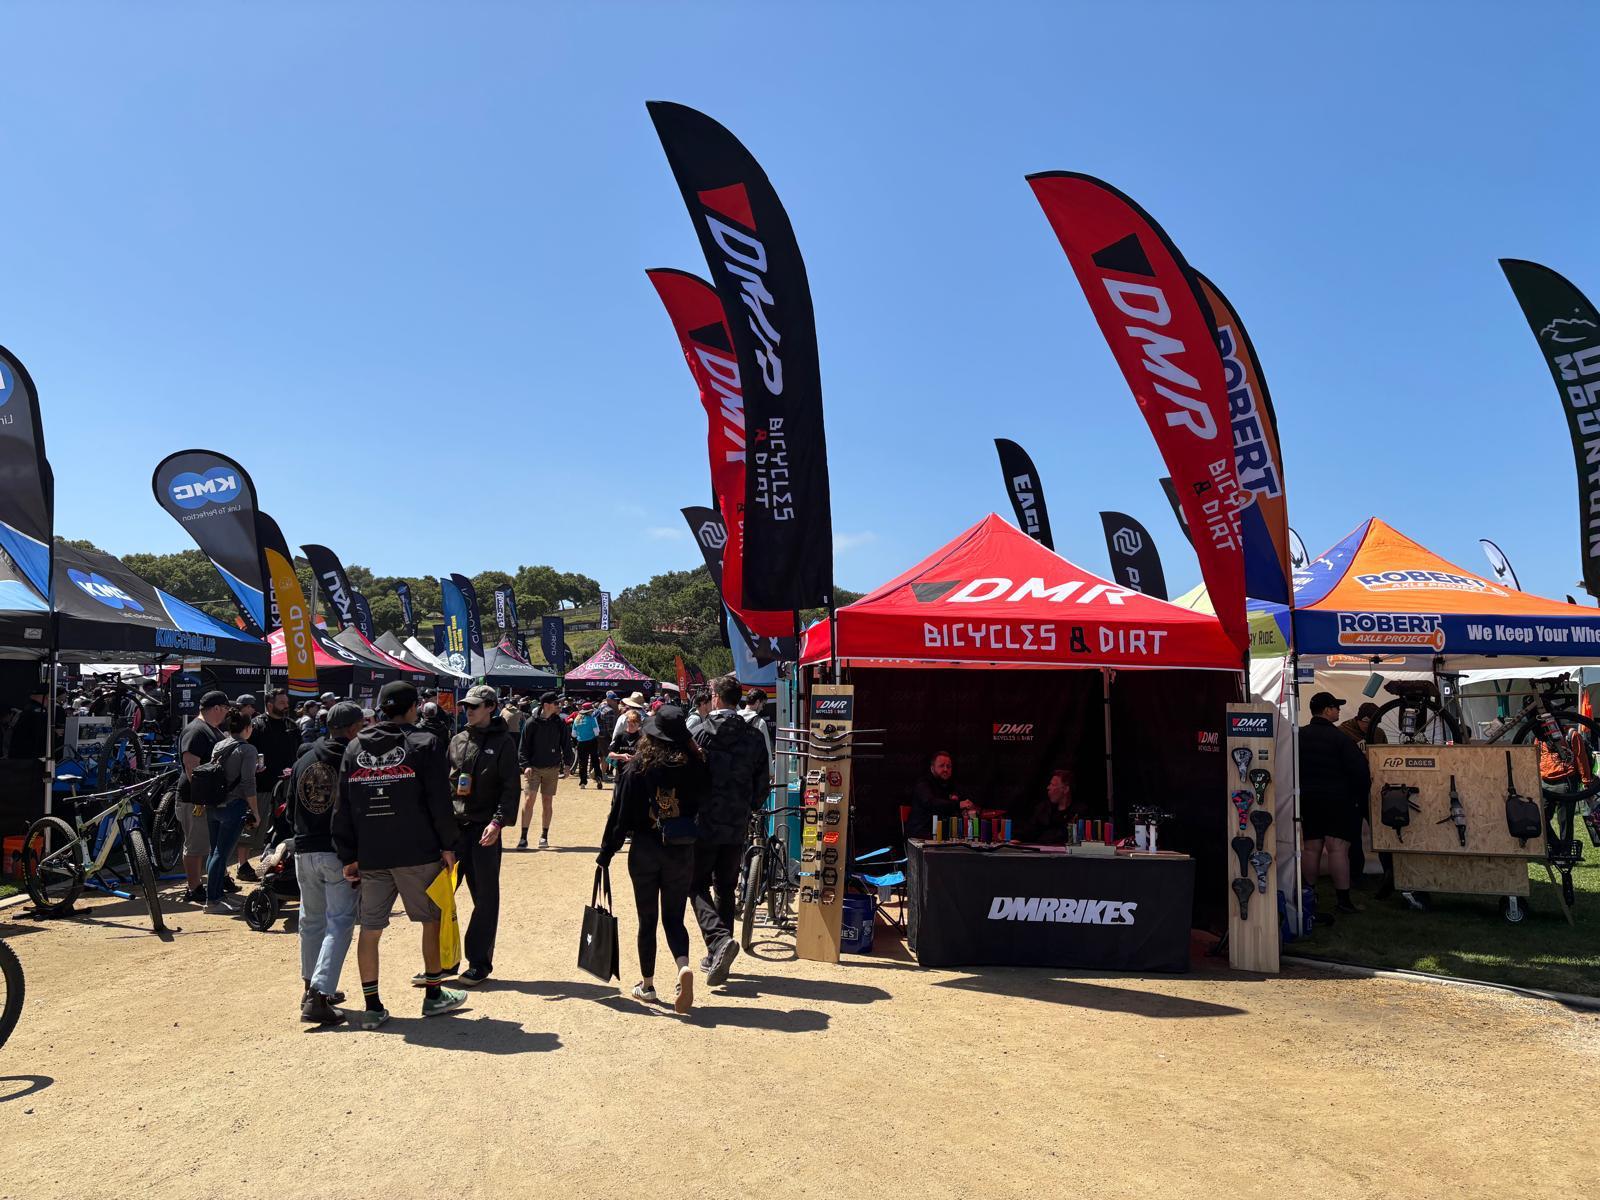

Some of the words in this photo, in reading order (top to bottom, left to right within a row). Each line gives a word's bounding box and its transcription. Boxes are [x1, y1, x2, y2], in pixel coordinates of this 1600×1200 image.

[705, 214, 783, 396] DMR
[1102, 277, 1218, 440] DMR
[755, 453, 769, 508] DIRT
[769, 418, 795, 521] BICYCLES
[1013, 473, 1041, 545] EAGL
[1202, 499, 1236, 551] DIRT
[77, 581, 135, 602] KMC
[945, 576, 1137, 607] DMR
[1358, 571, 1486, 588] ROBERT
[289, 605, 308, 664] GOLD
[923, 621, 1057, 652] BICYCLES
[1098, 627, 1168, 655] DIRT
[1339, 614, 1441, 632] ROBERT
[1356, 632, 1382, 643] AXLE
[1384, 634, 1430, 644] PROJECT
[1467, 624, 1493, 641] We
[1495, 624, 1534, 643] Keep
[1535, 625, 1569, 643] Your
[820, 700, 847, 709] DMR
[998, 723, 1034, 734] DMR
[1201, 731, 1219, 744] DMR
[1237, 718, 1268, 727] DMR
[987, 896, 1138, 926] DMRBIKES
